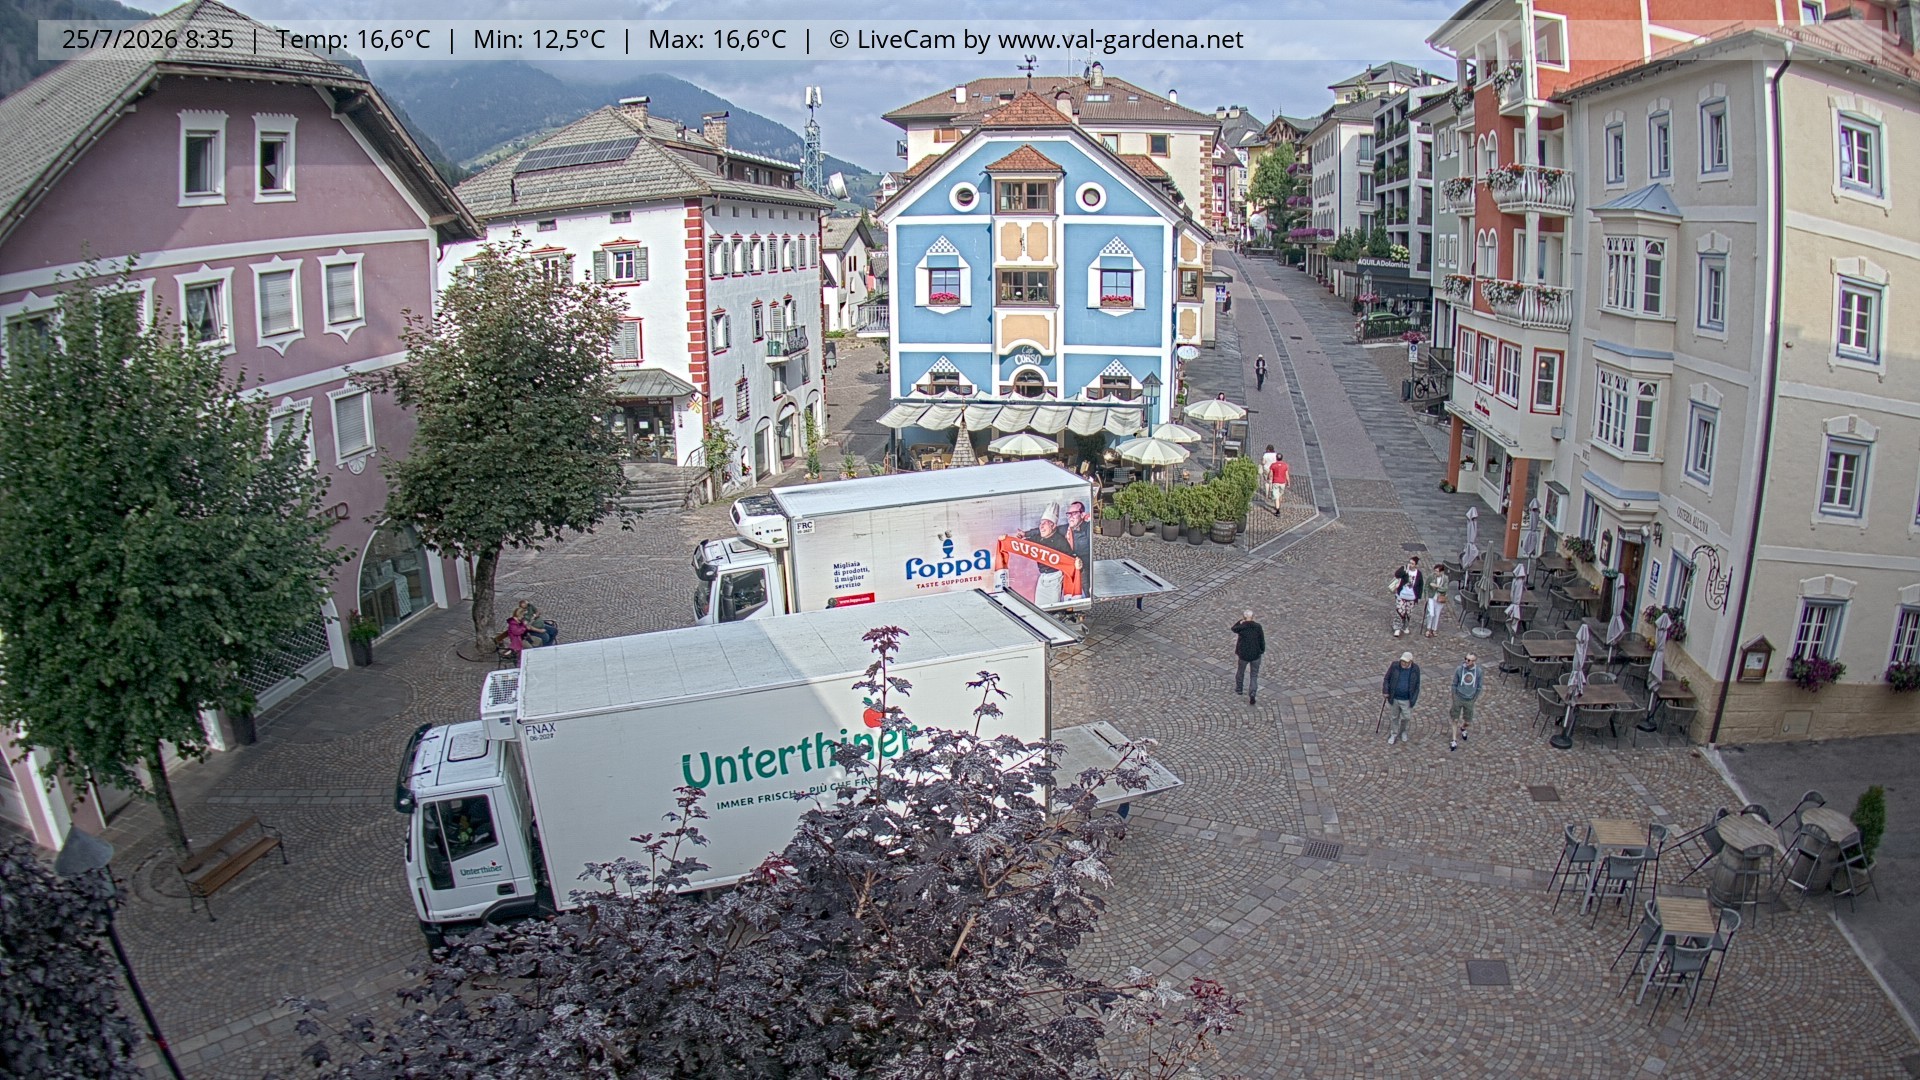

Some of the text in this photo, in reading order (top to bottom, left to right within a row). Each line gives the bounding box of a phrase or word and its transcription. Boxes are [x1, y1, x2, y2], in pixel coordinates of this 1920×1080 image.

[1014, 354, 1042, 365] CORSO
[797, 521, 813, 530] FRC
[1010, 540, 1060, 565] GUSTO
[833, 561, 861, 570] Migliaia
[905, 549, 991, 580] foppa
[841, 567, 871, 577] prodotti,
[841, 574, 865, 584] miglior
[916, 576, 983, 589] TASTE SUPPORTER
[834, 581, 861, 590] servizio
[525, 722, 557, 736] FNAX
[716, 797, 754, 810] IMMER
[757, 789, 797, 804] FRISCH
[809, 782, 828, 795] PIÙ
[459, 865, 503, 876] Unterthiner
